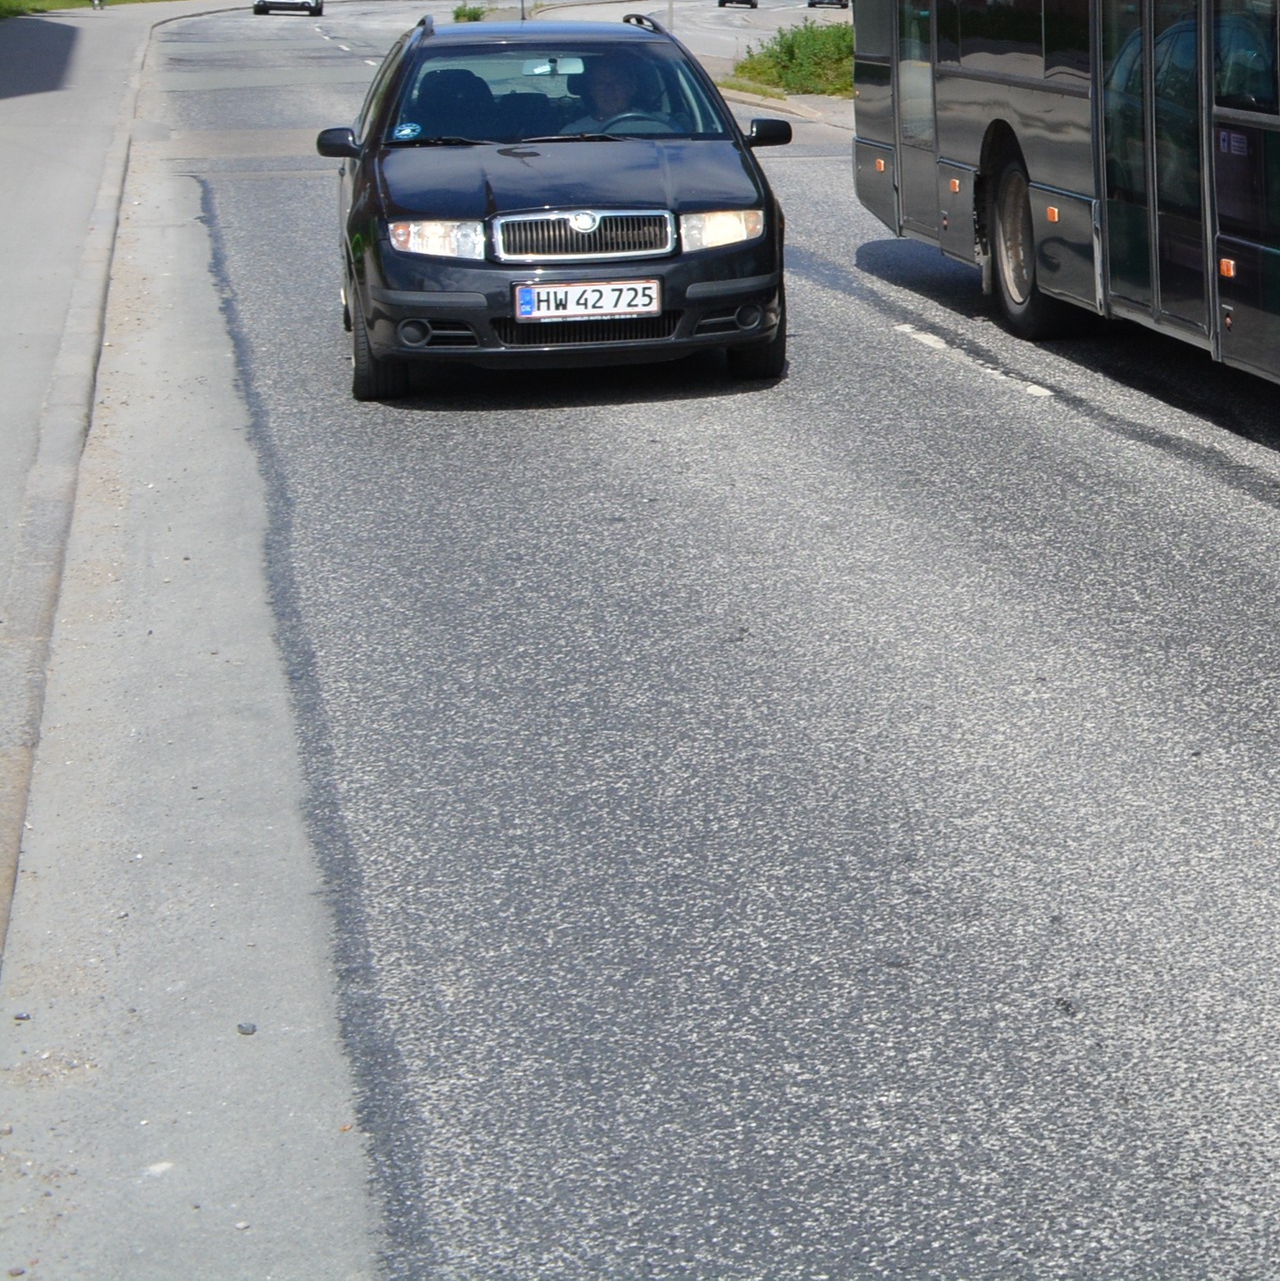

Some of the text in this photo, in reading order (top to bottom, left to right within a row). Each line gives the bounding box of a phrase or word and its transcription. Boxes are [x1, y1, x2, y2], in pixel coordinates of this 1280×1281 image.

[536, 286, 654, 311] HW 42 725
